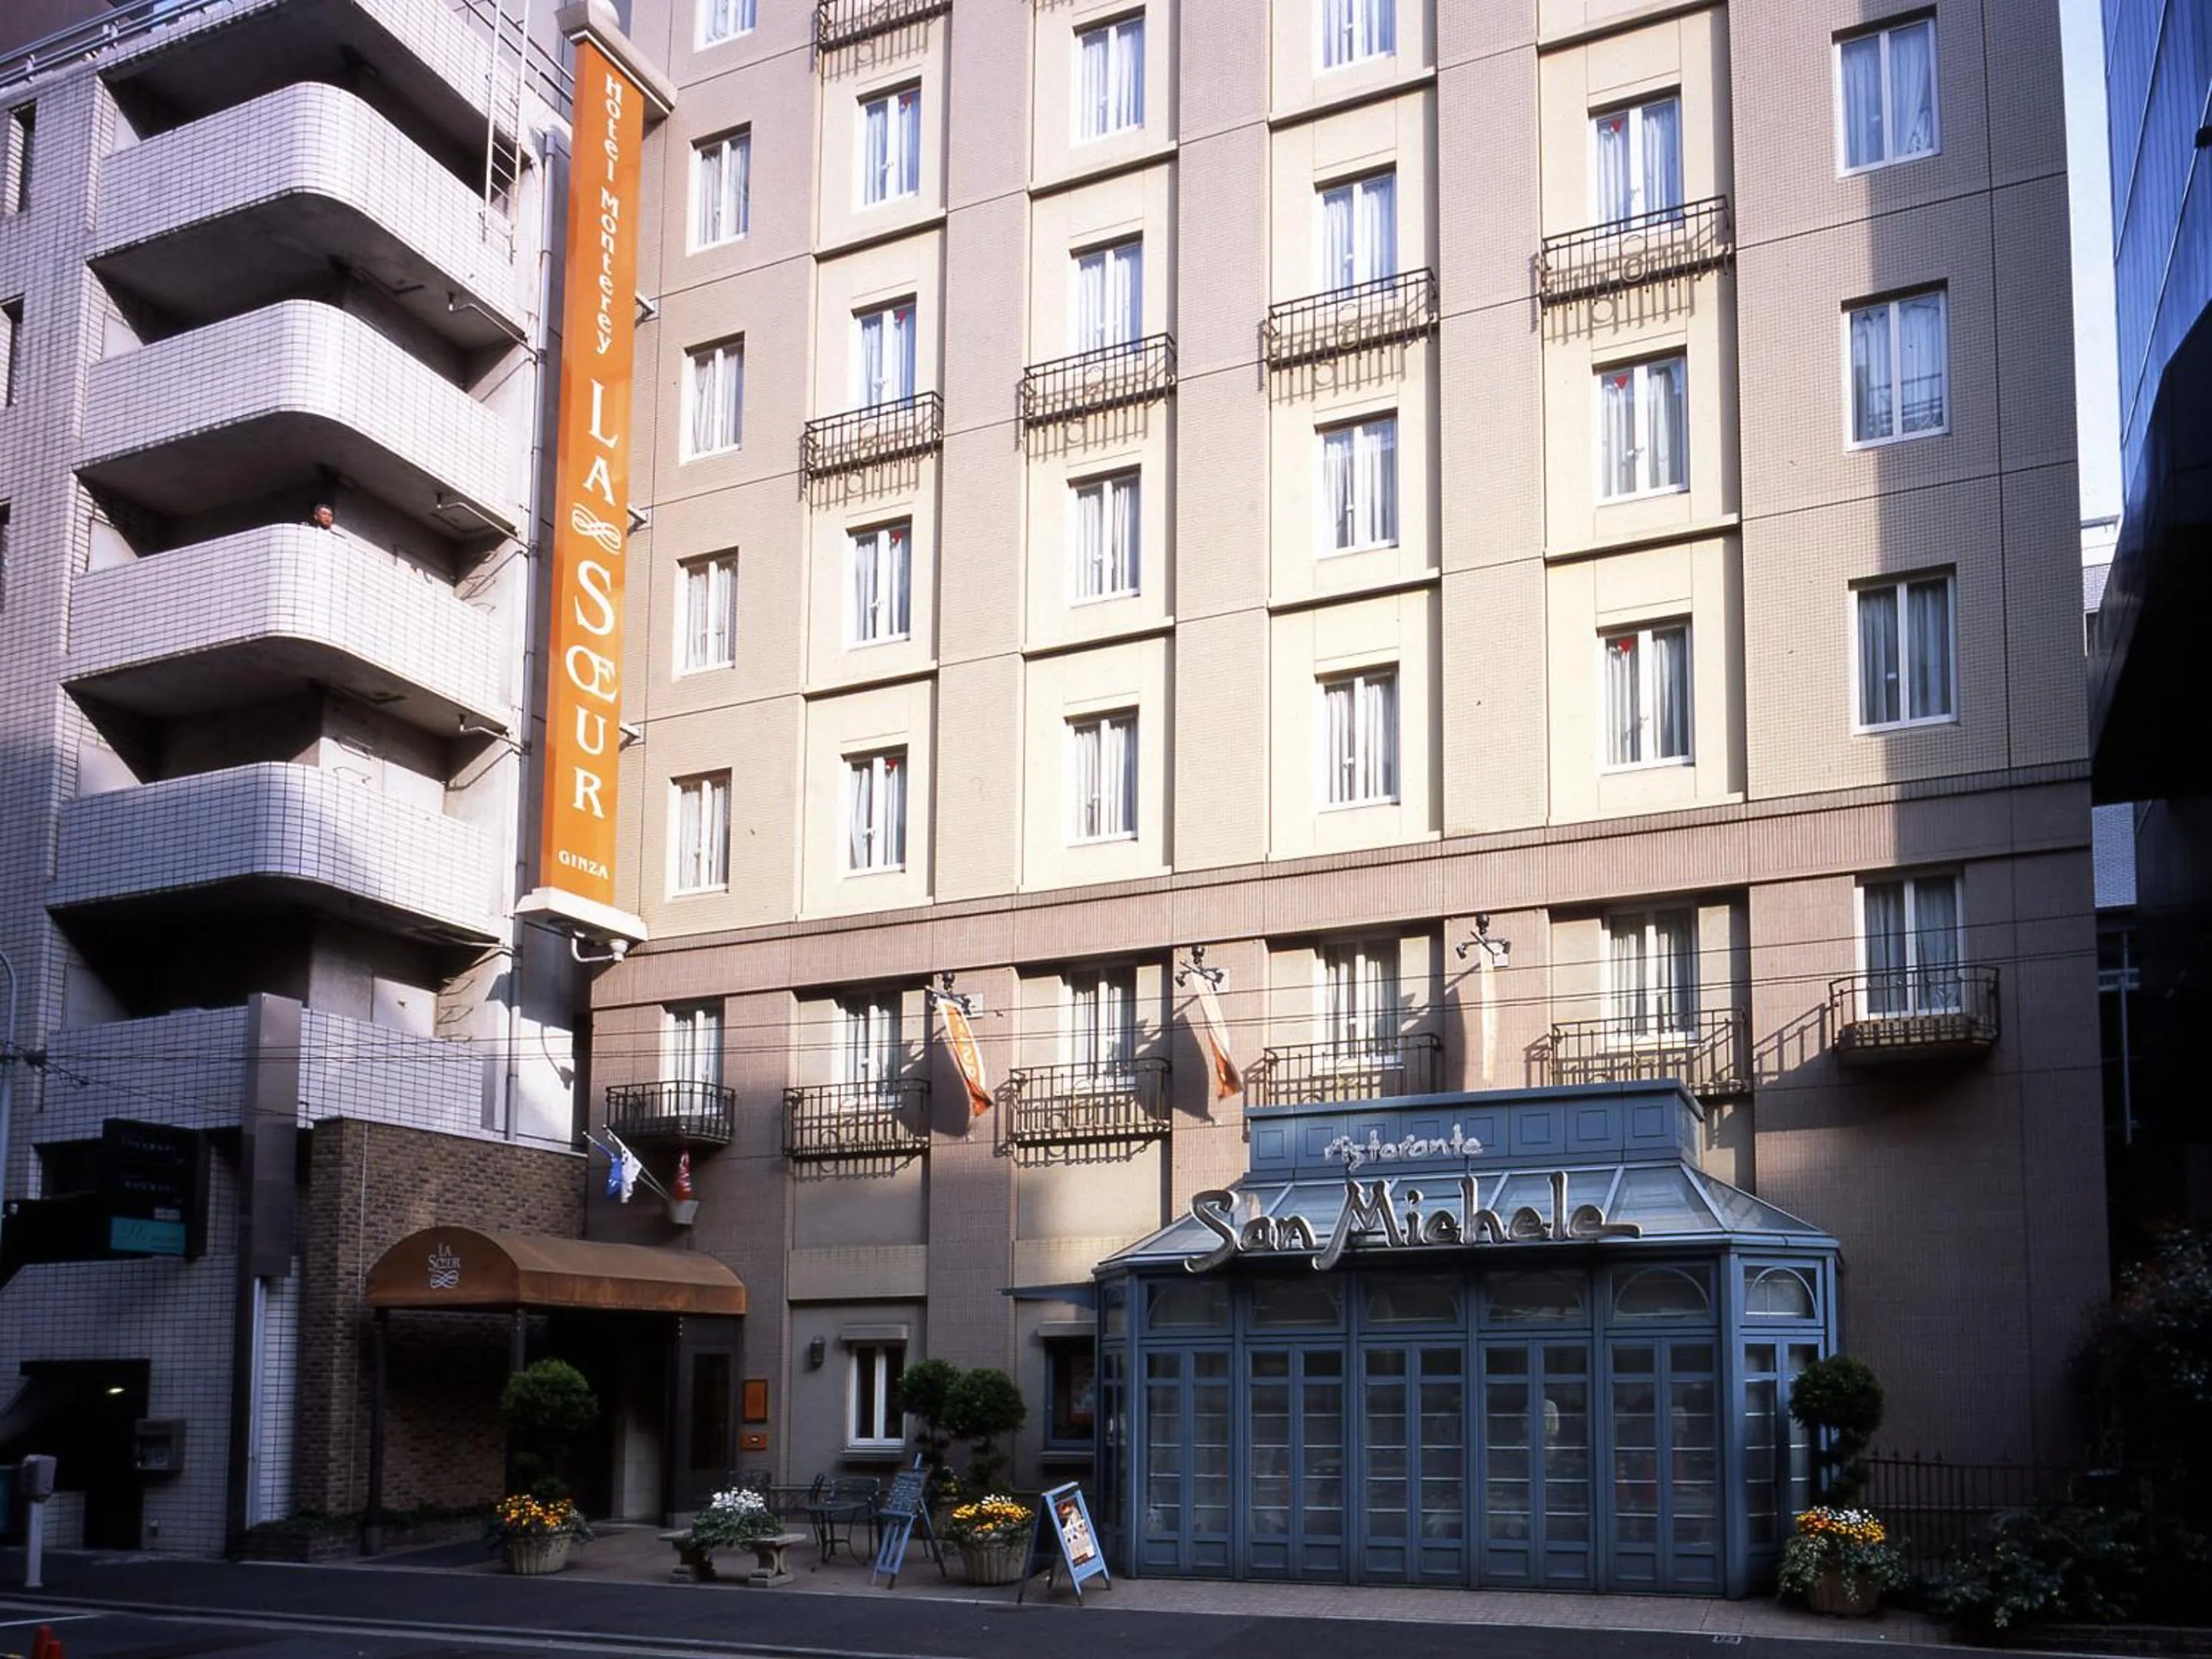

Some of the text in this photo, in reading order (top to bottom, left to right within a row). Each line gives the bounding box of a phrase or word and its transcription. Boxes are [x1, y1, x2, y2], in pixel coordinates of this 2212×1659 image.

[558, 849, 609, 880] GINZA
[1184, 1170, 1643, 1273] San Michele
